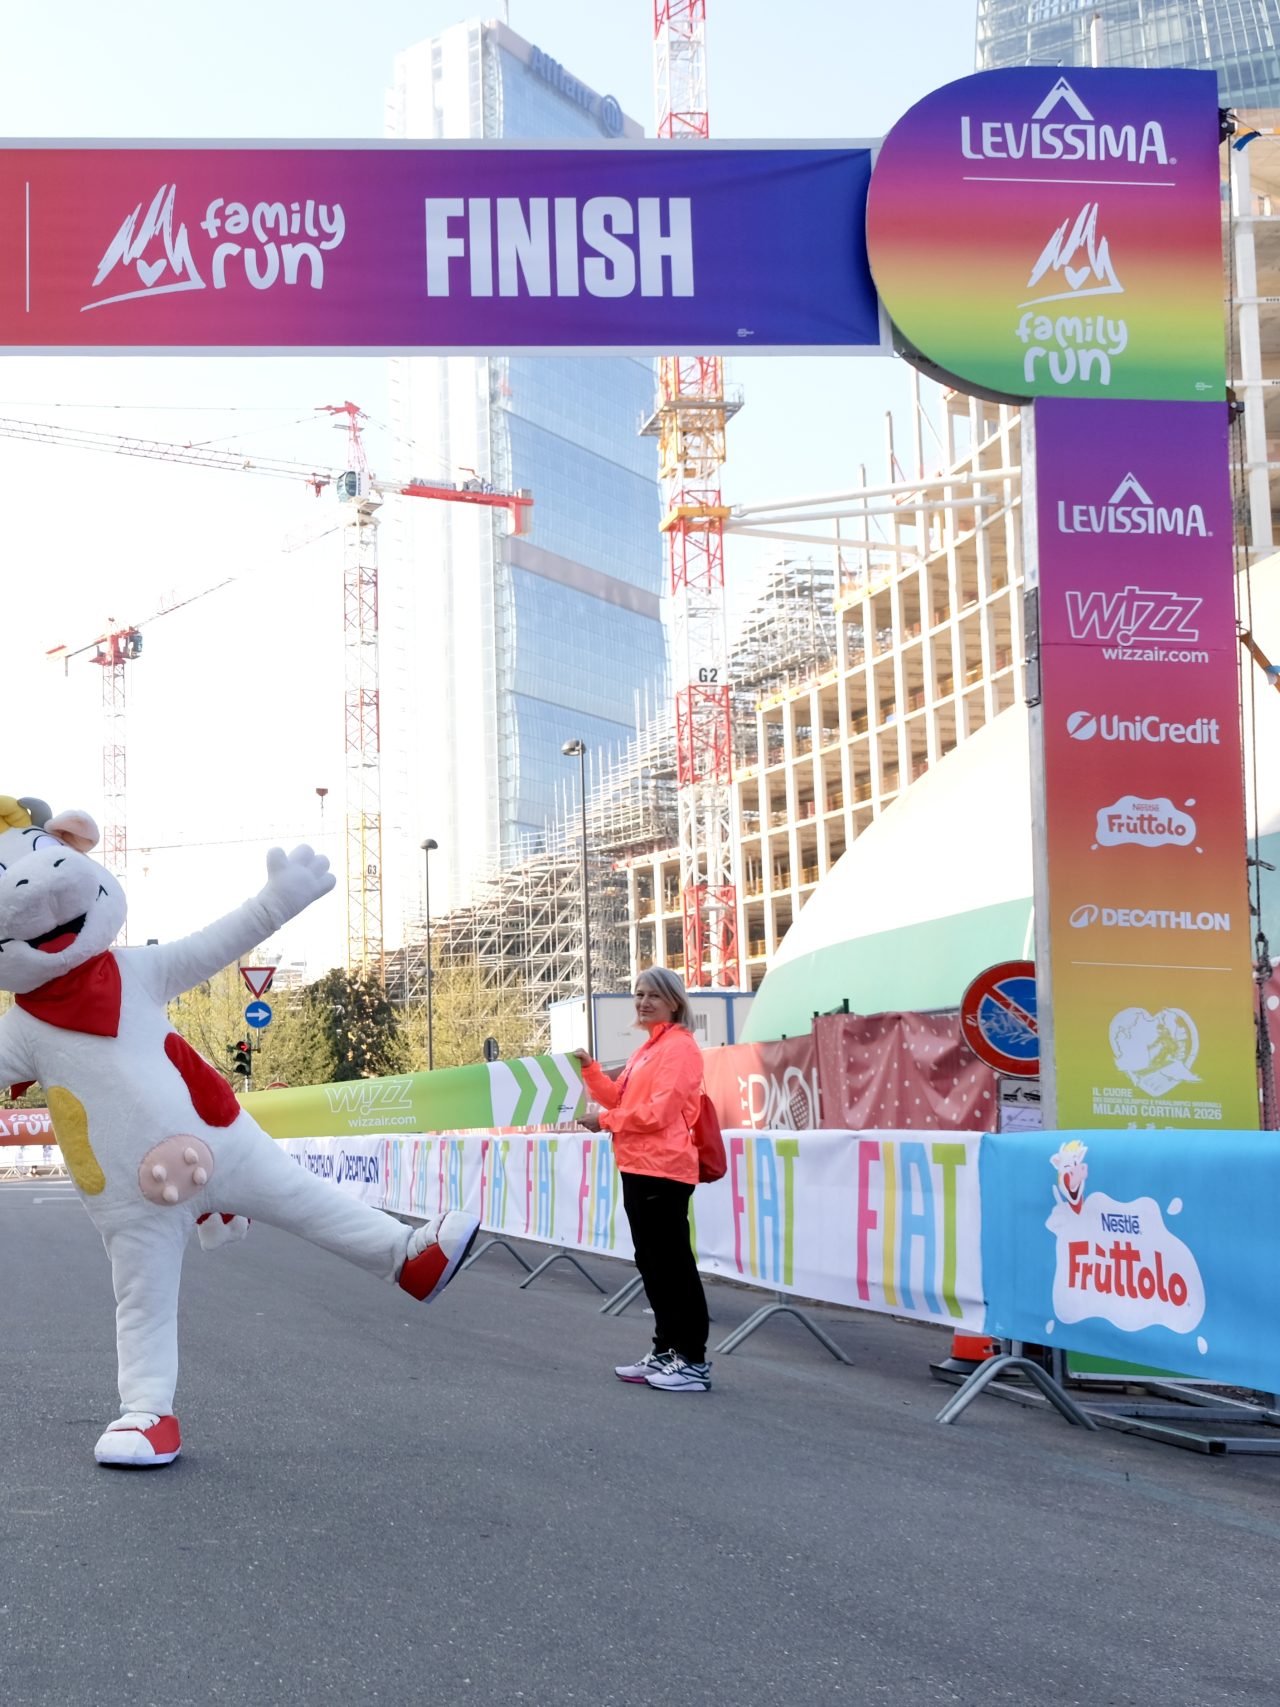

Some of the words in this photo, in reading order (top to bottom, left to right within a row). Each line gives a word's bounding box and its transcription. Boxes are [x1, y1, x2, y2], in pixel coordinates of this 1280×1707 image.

[960, 115, 1169, 166] LEVISSIMA
[200, 197, 346, 251] family
[424, 195, 696, 298] FINISH
[211, 241, 324, 291] run
[1014, 311, 1128, 355] family
[1023, 344, 1112, 386] run
[1057, 500, 1207, 537] LEVISSIMA
[1102, 646, 1210, 664] wizzair.com
[698, 667, 719, 683] G2
[1100, 715, 1221, 745] UniCredit
[1107, 814, 1187, 837] Frùttolo
[367, 864, 377, 875] G3
[1101, 907, 1231, 932] DECATHLON
[1092, 1087, 1102, 1097] IL
[1103, 1088, 1133, 1098] CUORE
[8, 1113, 50, 1122] fami
[348, 1114, 417, 1128] wizzair.com
[1092, 1103, 1138, 1117] MILANO
[1140, 1105, 1191, 1119] CORTINA
[1194, 1108, 1223, 1121] 2026
[344, 1154, 380, 1185] DECATHLON
[438, 1140, 465, 1215] FIAT
[480, 1140, 510, 1230] FIAT
[525, 1139, 558, 1240] FIAT
[730, 1138, 800, 1287] FIAT
[856, 1140, 967, 1320] FIAT
[1068, 1240, 1188, 1307] Frùttolo
